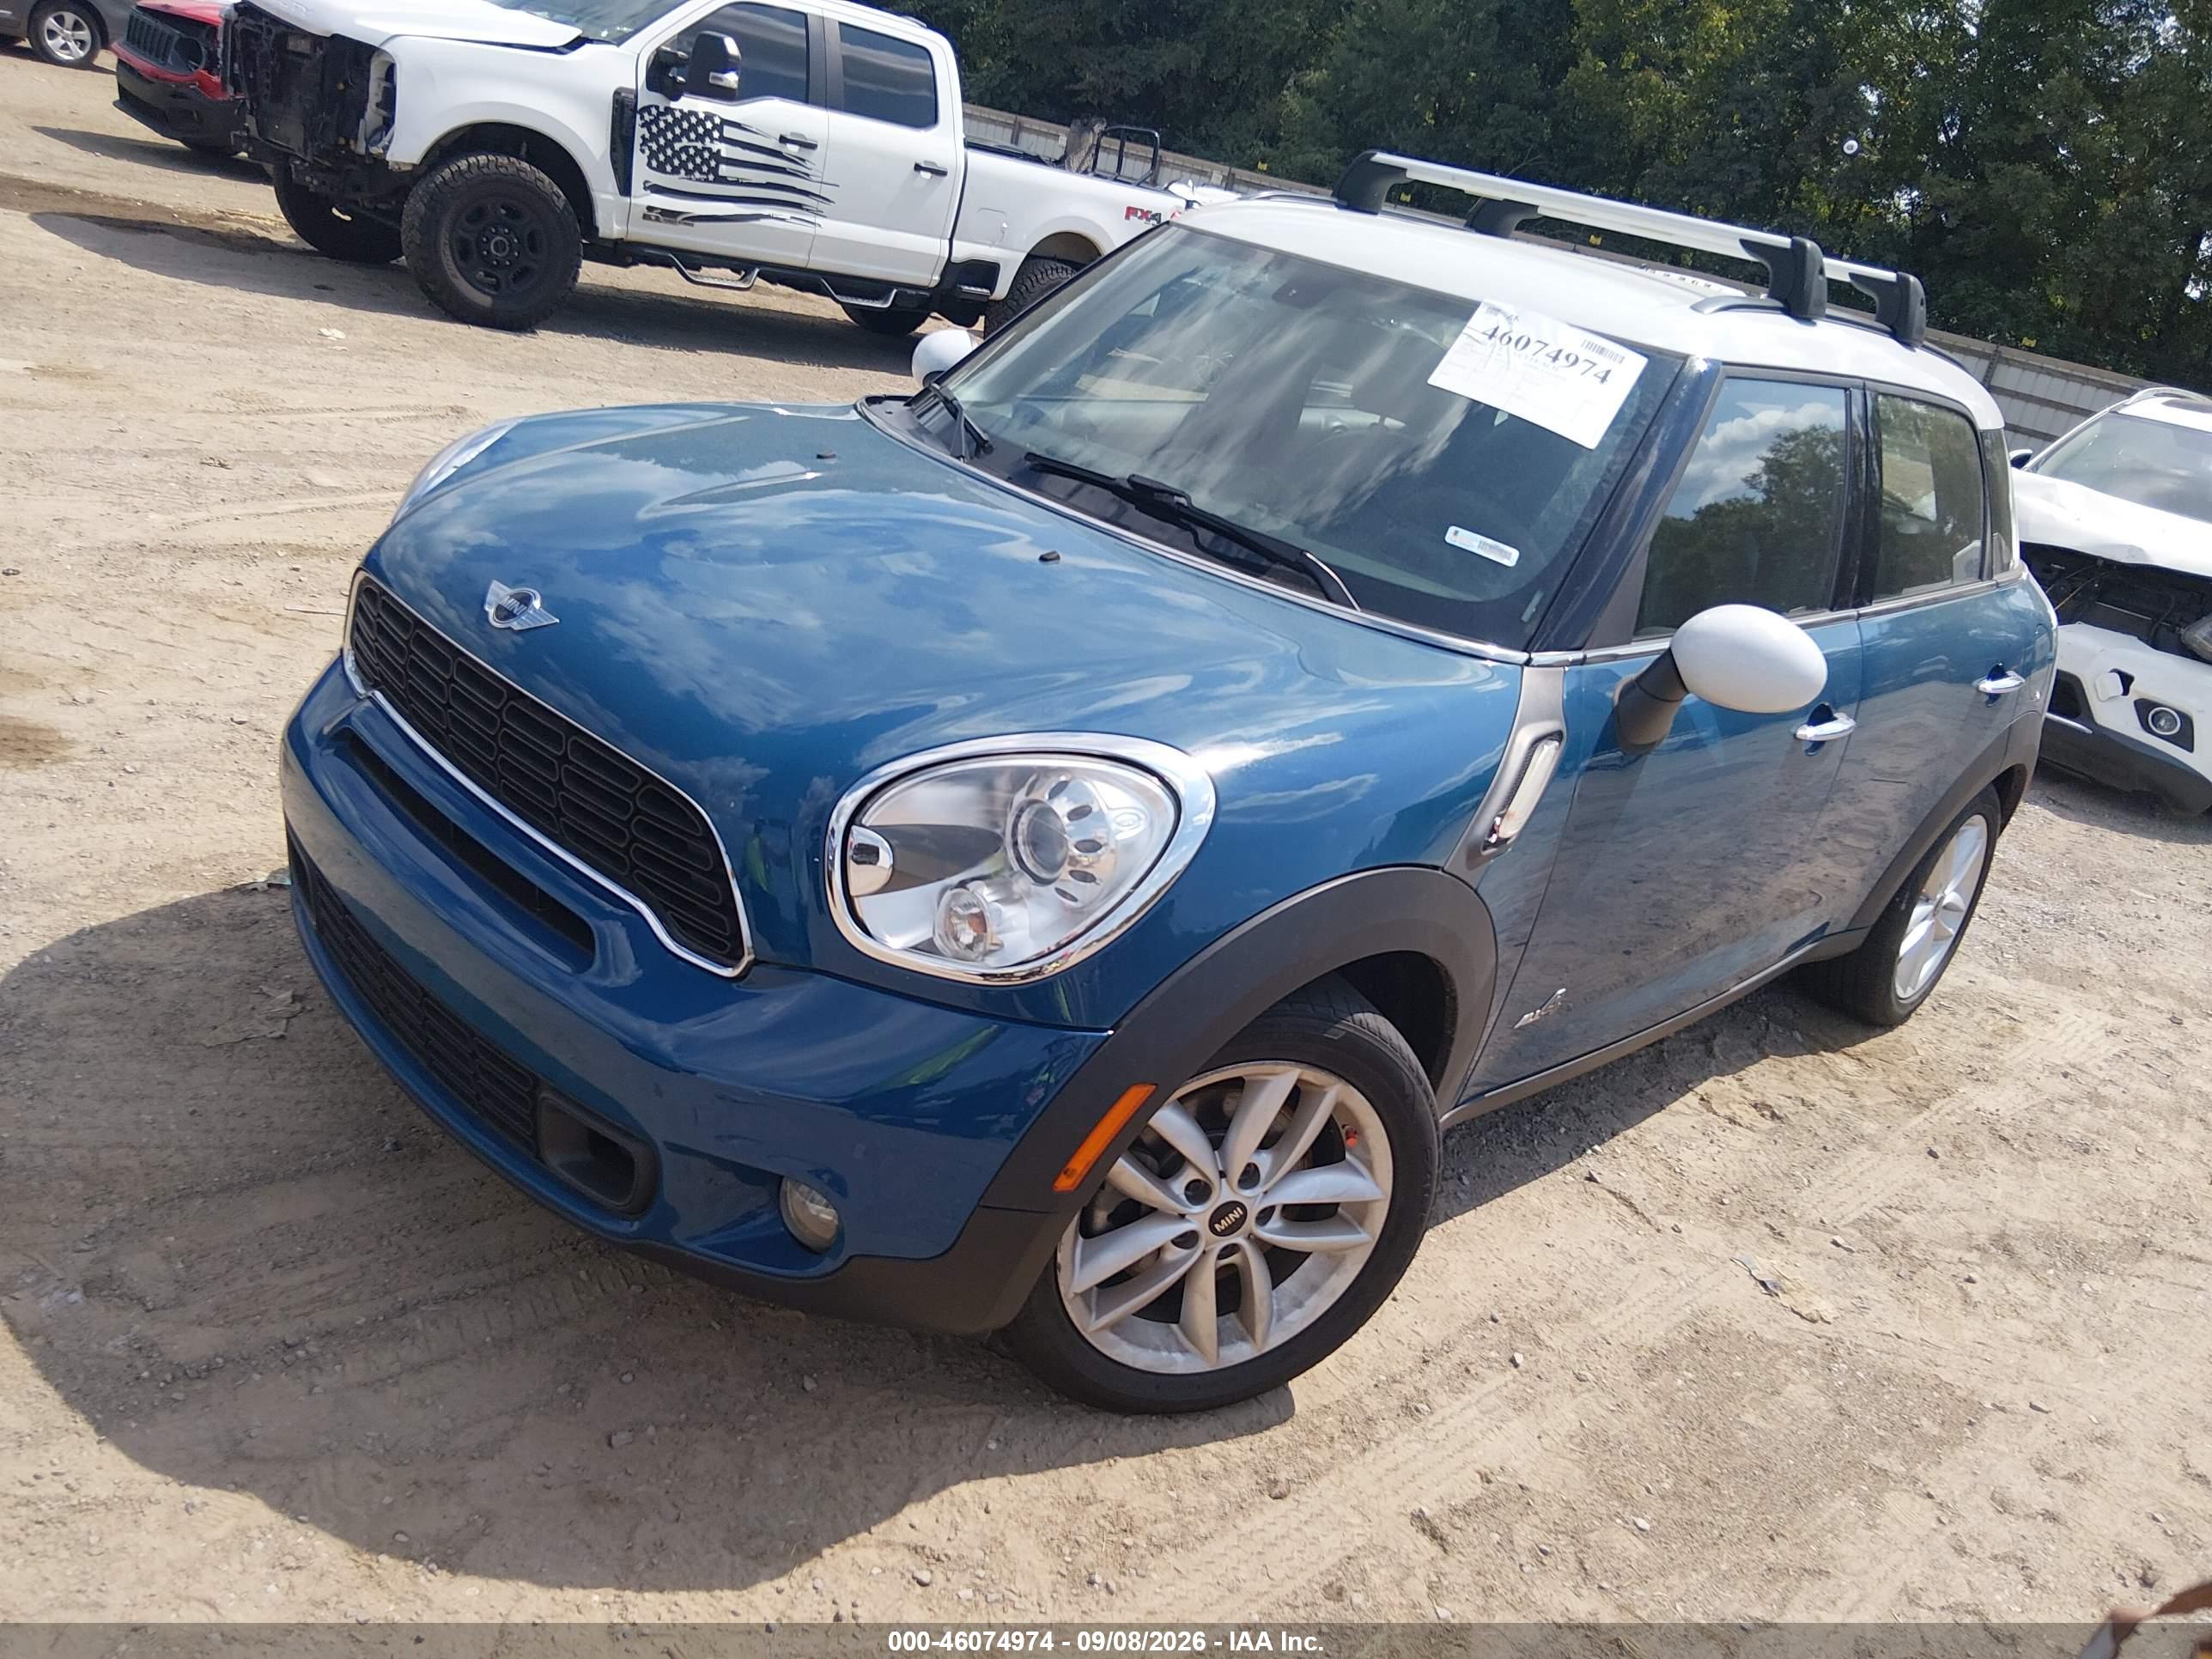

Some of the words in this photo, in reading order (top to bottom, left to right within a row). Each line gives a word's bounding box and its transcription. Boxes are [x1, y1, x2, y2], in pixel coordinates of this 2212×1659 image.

[1125, 206, 1162, 224] FX4
[1482, 325, 1613, 385] 46074974
[500, 598, 529, 616] MINI
[1213, 1206, 1243, 1232] MINI
